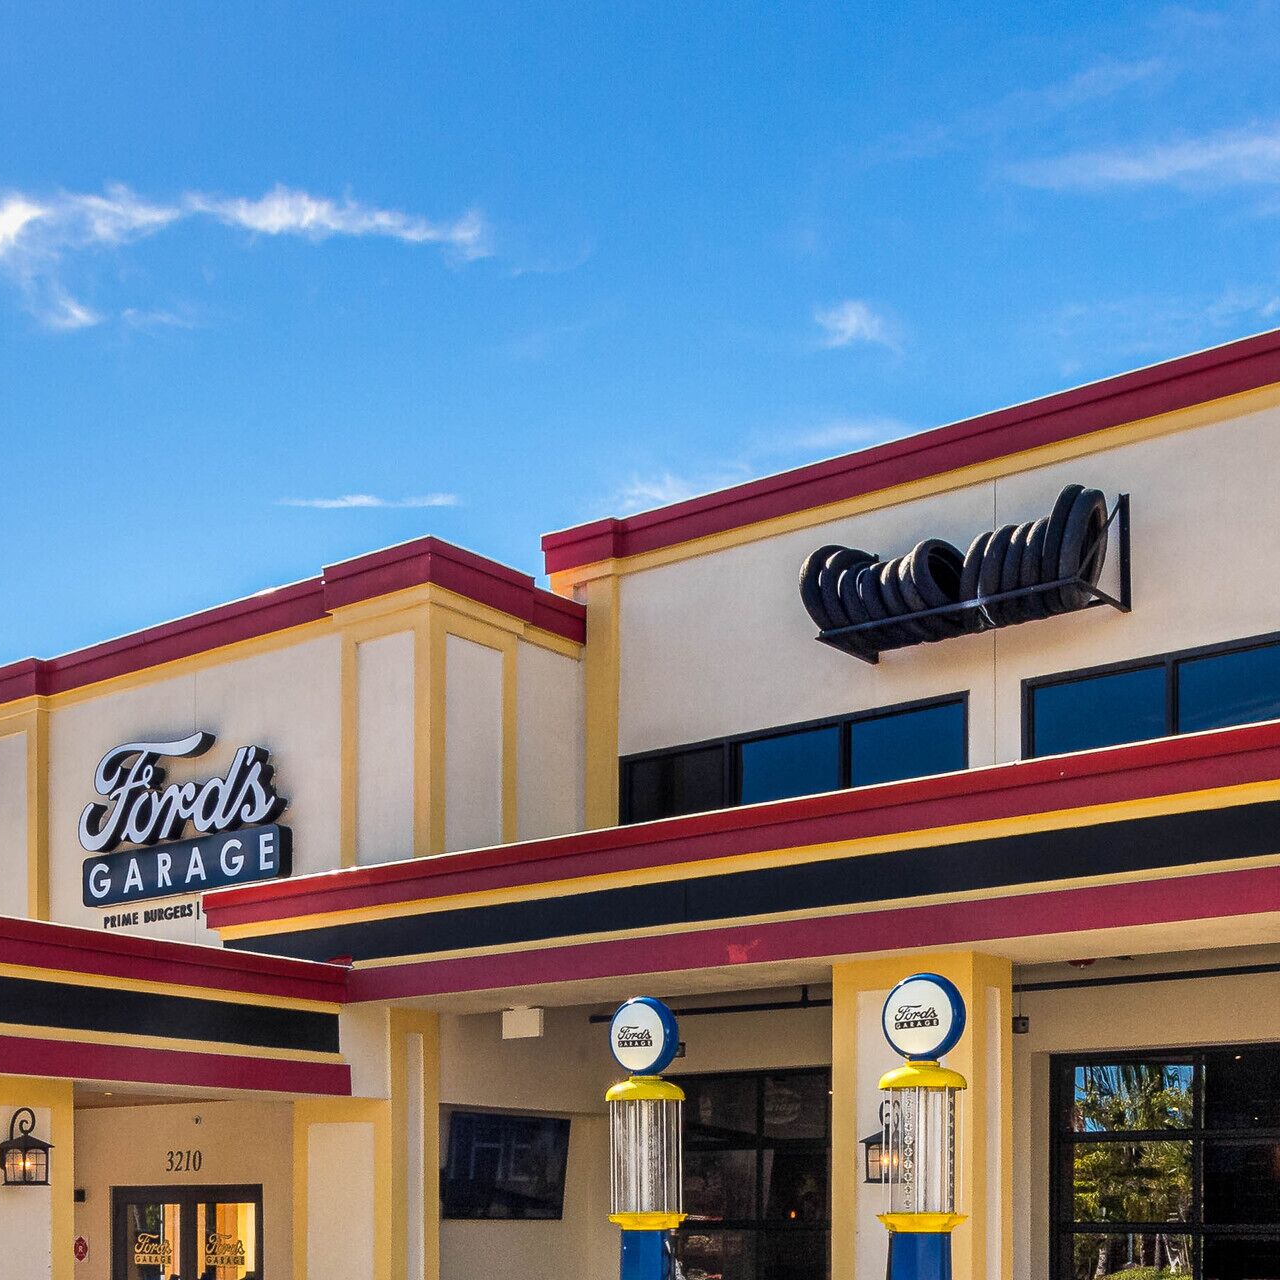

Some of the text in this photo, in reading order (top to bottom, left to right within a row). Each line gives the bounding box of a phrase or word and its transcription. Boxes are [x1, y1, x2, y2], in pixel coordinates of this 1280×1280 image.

[78, 731, 276, 851] Ford's
[88, 832, 275, 899] GARAGE
[103, 903, 193, 929] PRIME BURGERS
[895, 1004, 938, 1021] Ford's
[618, 1026, 652, 1040] Ford's
[895, 1018, 939, 1029] GARAGE
[166, 1150, 202, 1171] 3210
[134, 1233, 173, 1254] Ford's
[206, 1233, 245, 1255] Ford's
[135, 1254, 172, 1264] GARAGE
[206, 1255, 245, 1265] GARAGE
